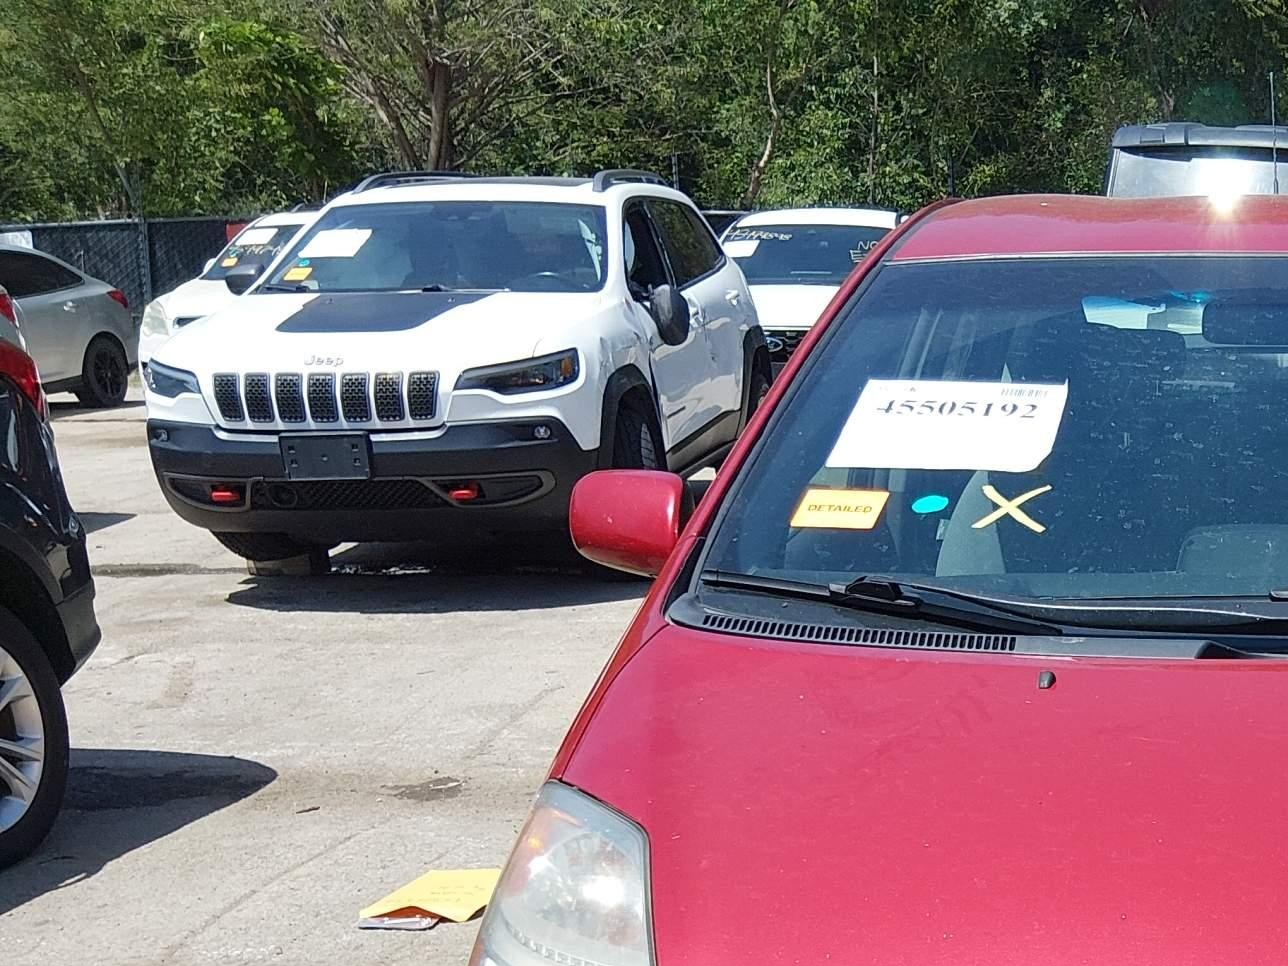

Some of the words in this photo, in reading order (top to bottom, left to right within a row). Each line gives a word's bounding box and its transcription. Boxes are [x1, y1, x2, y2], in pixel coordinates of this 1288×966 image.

[303, 354, 345, 368] Jeep
[876, 399, 1038, 419] 45505192
[807, 503, 873, 514] DETAILED
